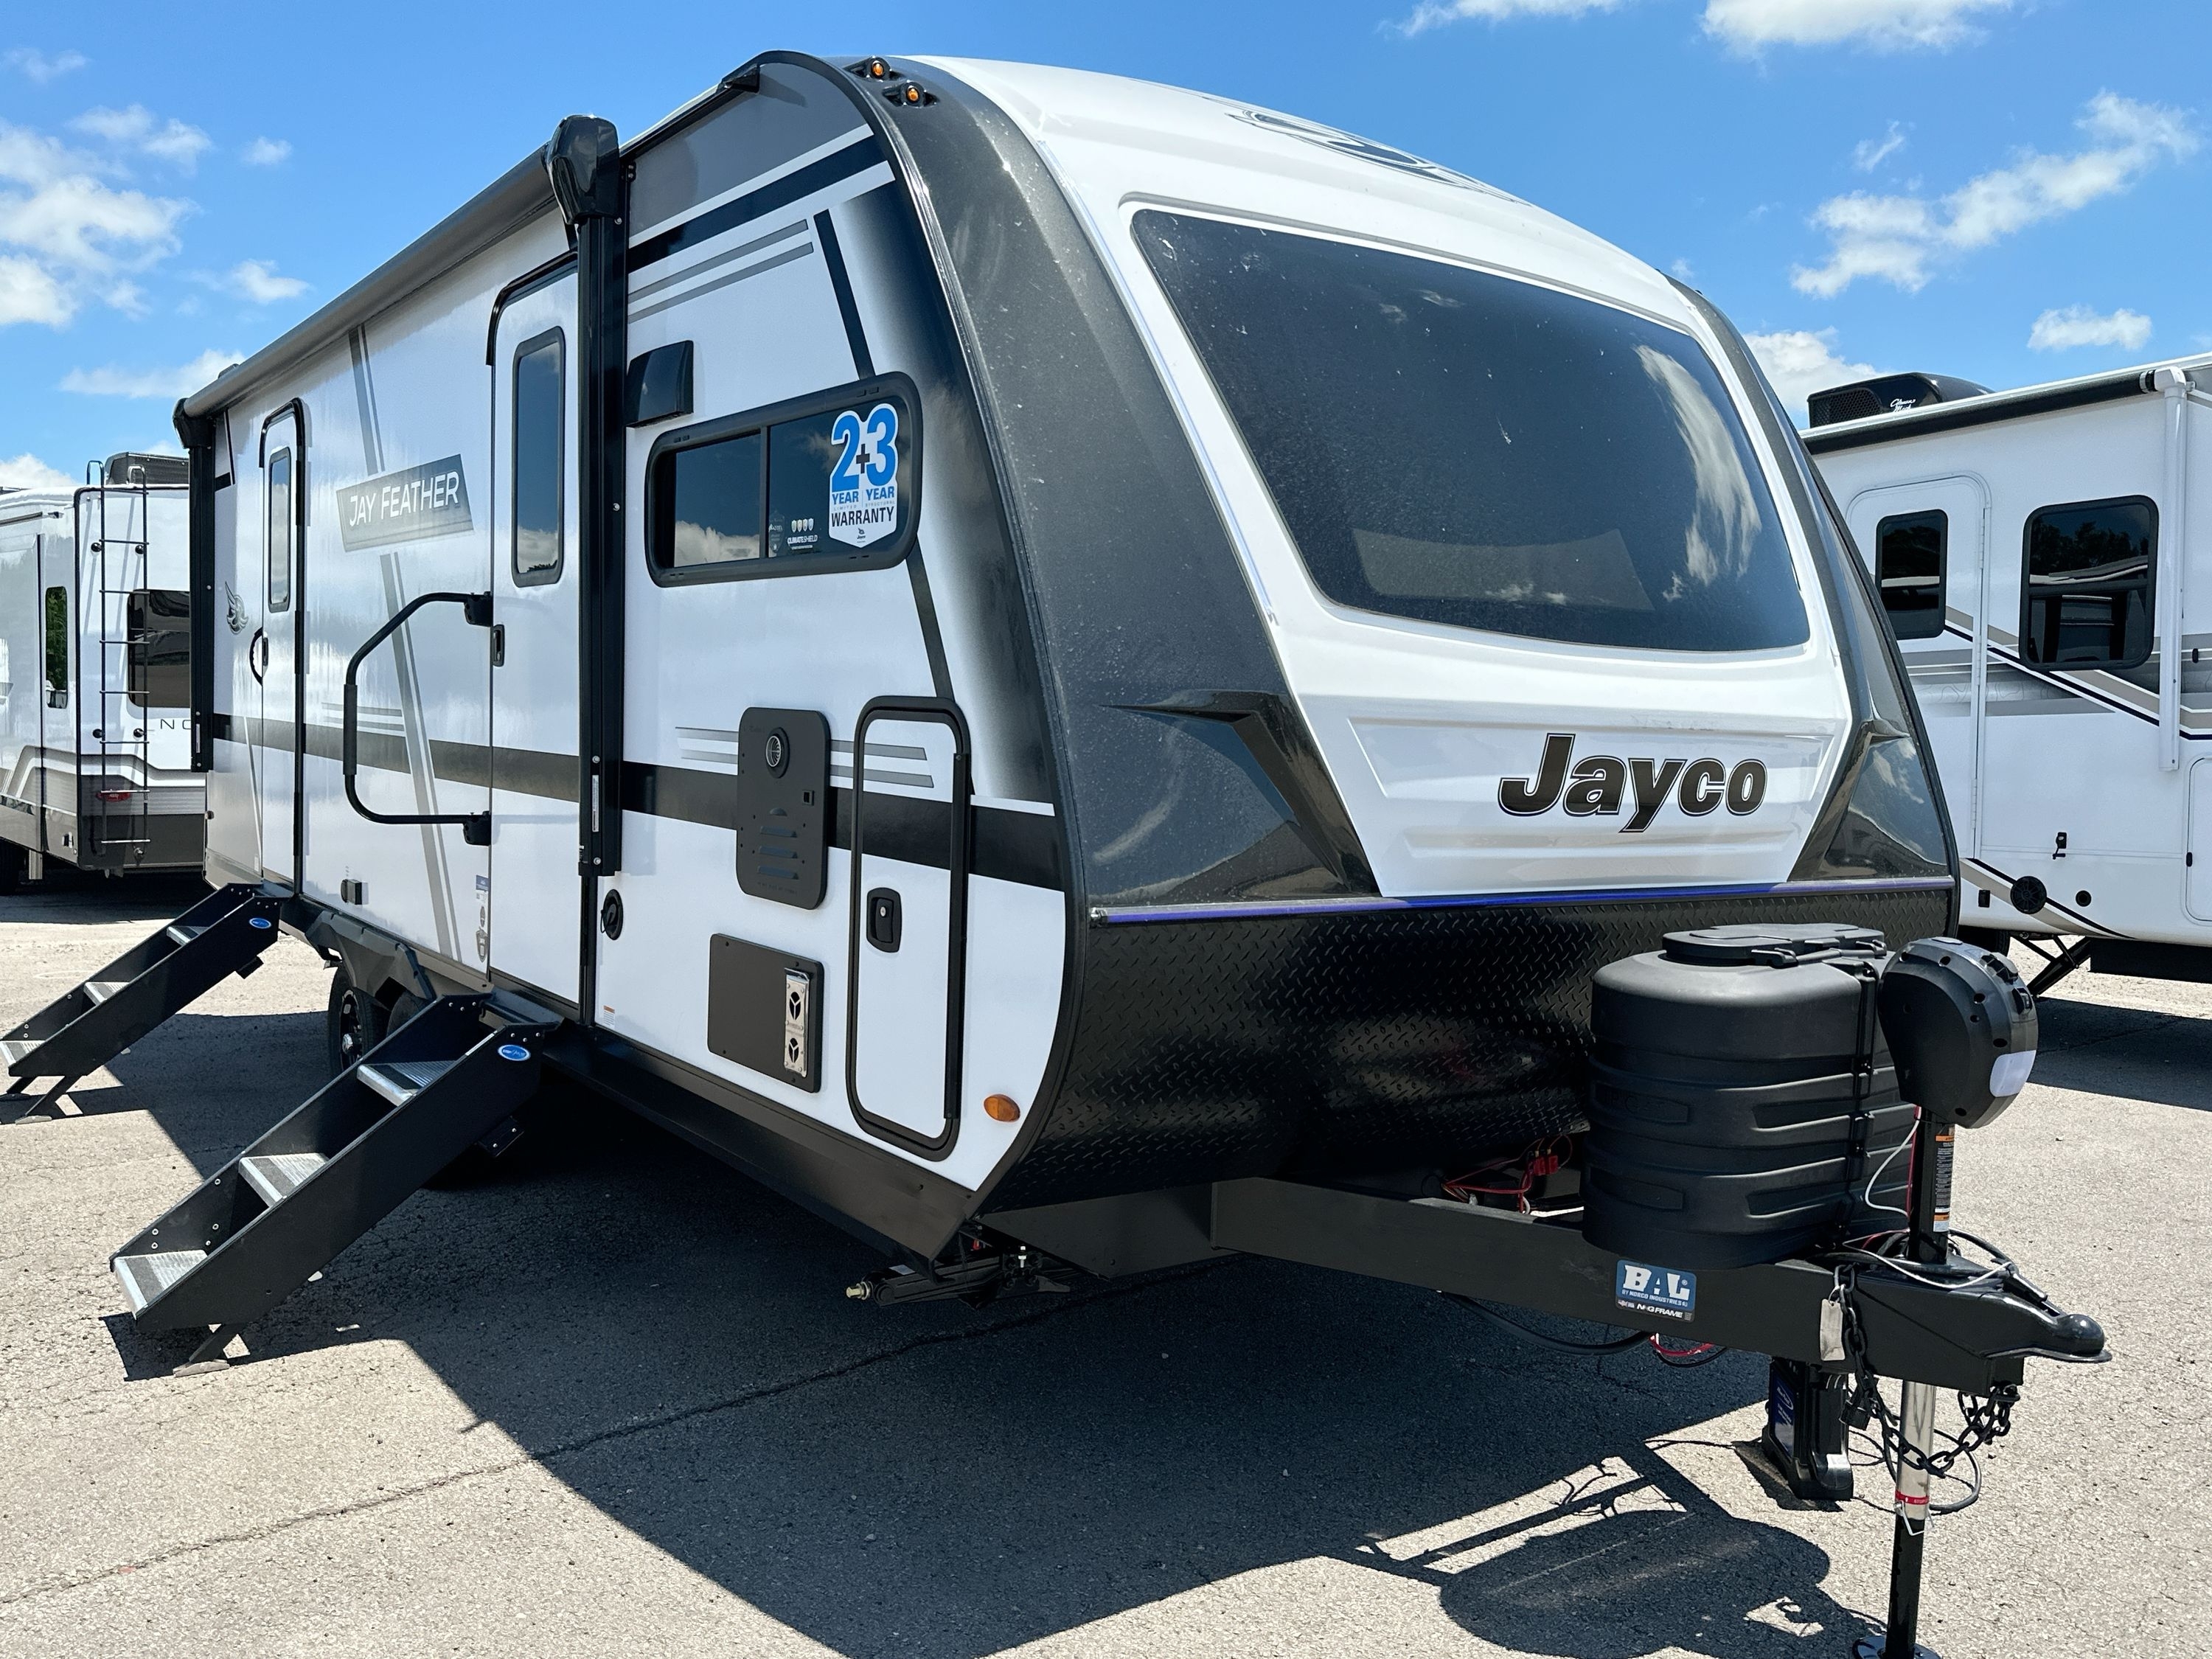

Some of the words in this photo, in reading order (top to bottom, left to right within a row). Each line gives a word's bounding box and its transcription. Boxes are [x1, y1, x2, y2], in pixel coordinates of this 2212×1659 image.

[349, 493, 377, 527] JAY
[381, 470, 459, 521] FEATHER
[832, 491, 859, 505] YEAR
[866, 486, 894, 501] YEAR
[832, 506, 894, 527] WARRANTY
[1498, 732, 1768, 833] Jayco
